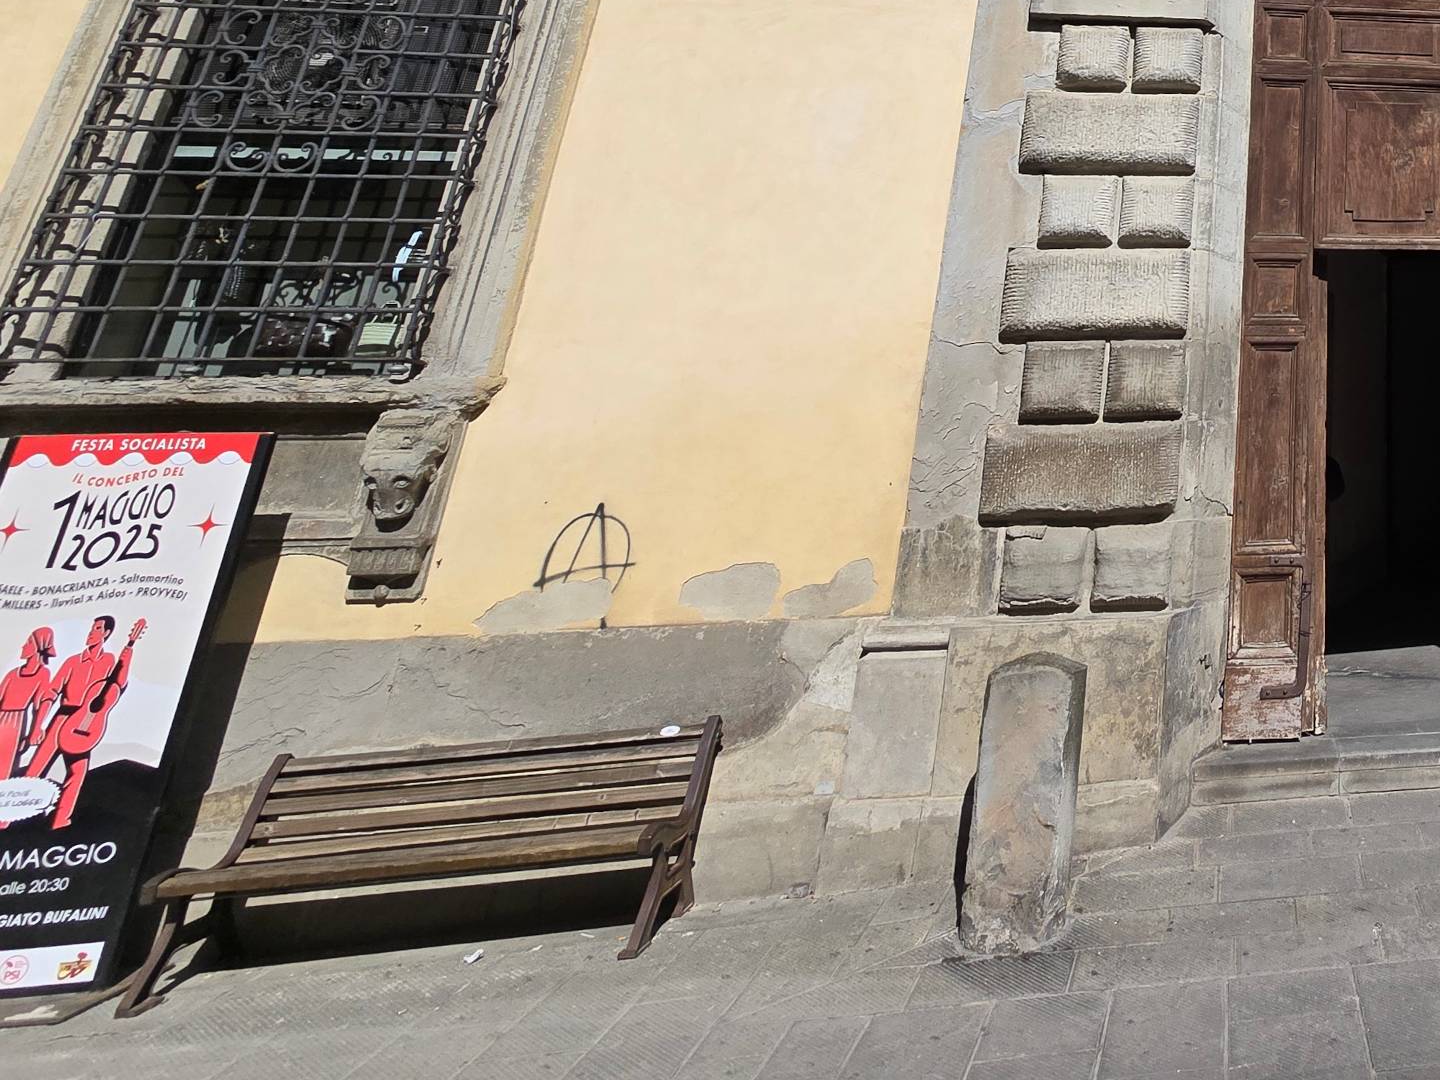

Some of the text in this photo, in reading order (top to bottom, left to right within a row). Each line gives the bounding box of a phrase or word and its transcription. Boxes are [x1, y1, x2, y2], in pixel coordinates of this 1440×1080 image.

[71, 438, 207, 451] FESTA SOCIALISTA
[72, 467, 184, 487] IL CONCERTO DEL
[45, 483, 176, 569] 1 MAGGIO
[61, 523, 163, 571] 2025
[32, 577, 109, 596] BONACRIANZA
[2, 600, 42, 609] MILLERS
[96, 590, 126, 601] Aidos
[0, 841, 117, 870] MAGGIO
[0, 877, 70, 896] alle 20:30
[43, 906, 109, 924] BUFALINI
